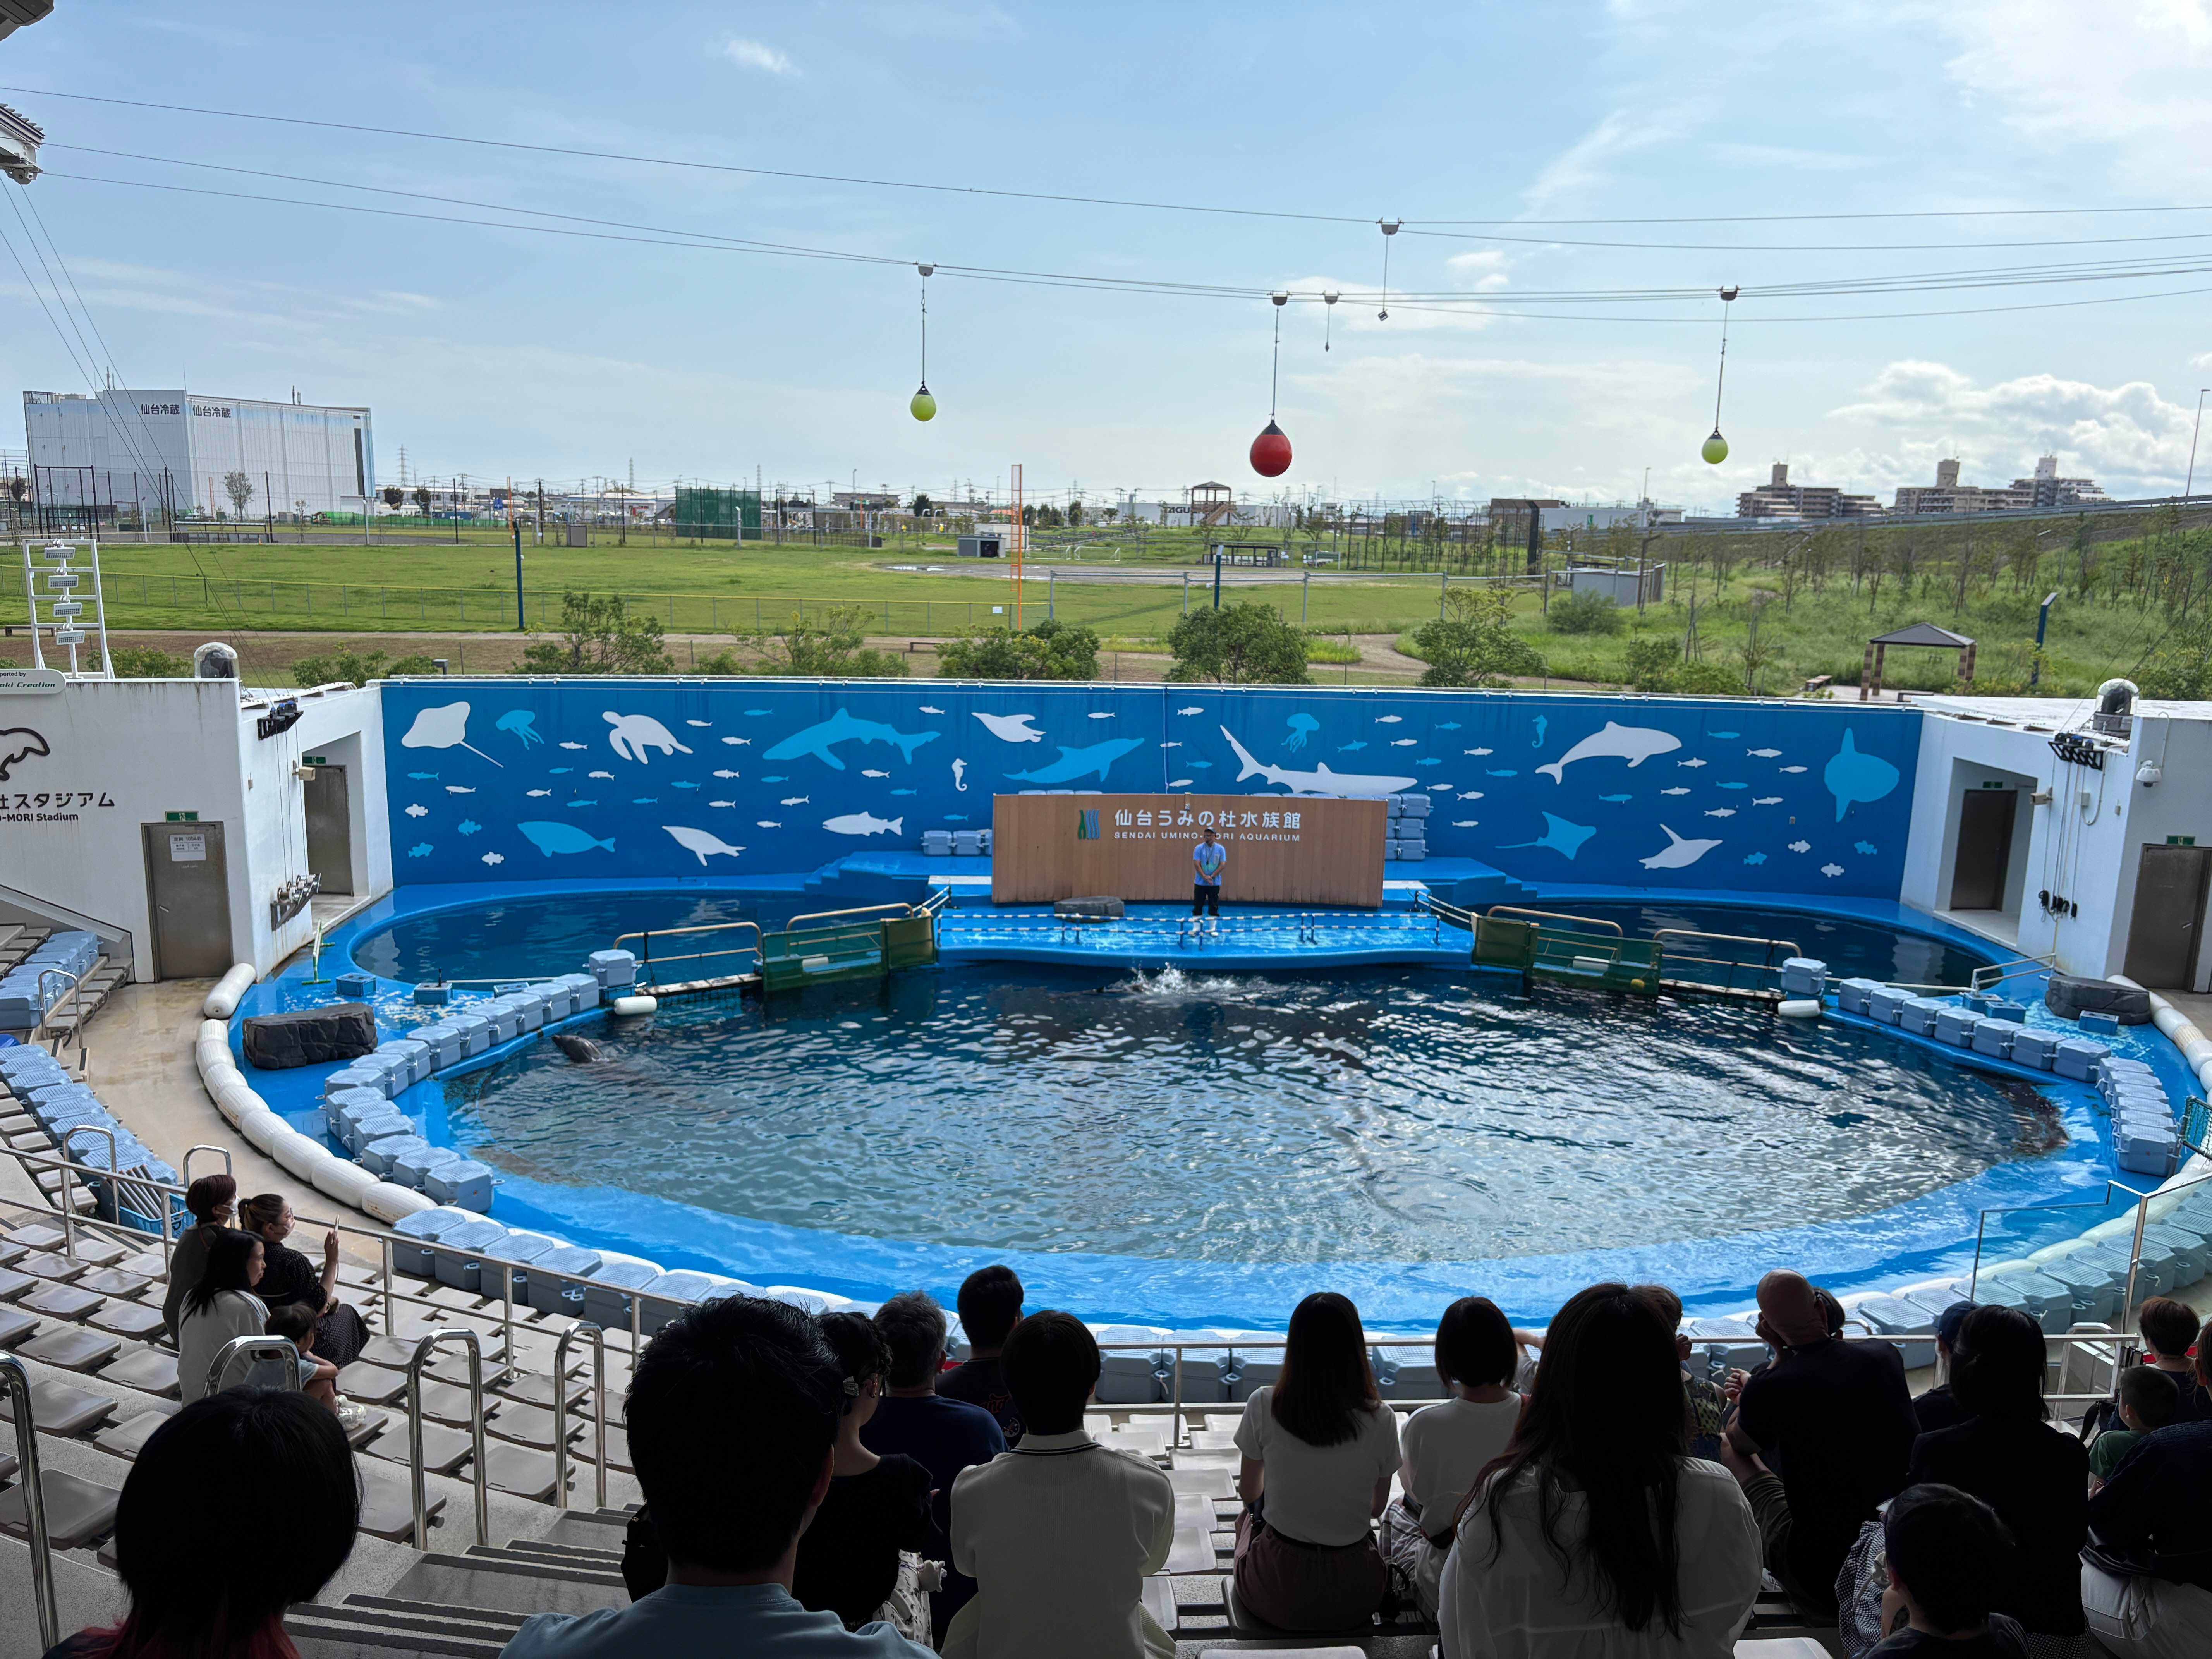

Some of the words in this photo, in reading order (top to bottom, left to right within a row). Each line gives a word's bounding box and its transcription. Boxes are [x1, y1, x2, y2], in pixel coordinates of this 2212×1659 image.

[141, 404, 180, 414] 仙台冷蔵
[193, 405, 231, 418] 仙台冷蔵
[0, 813, 33, 822] -MORI
[37, 813, 78, 821] Stadium
[1115, 809, 1301, 829] 仙台うみの杜水族館
[1161, 832, 1233, 840] UMINO-ORI
[1239, 833, 1300, 842] AQUARIUM
